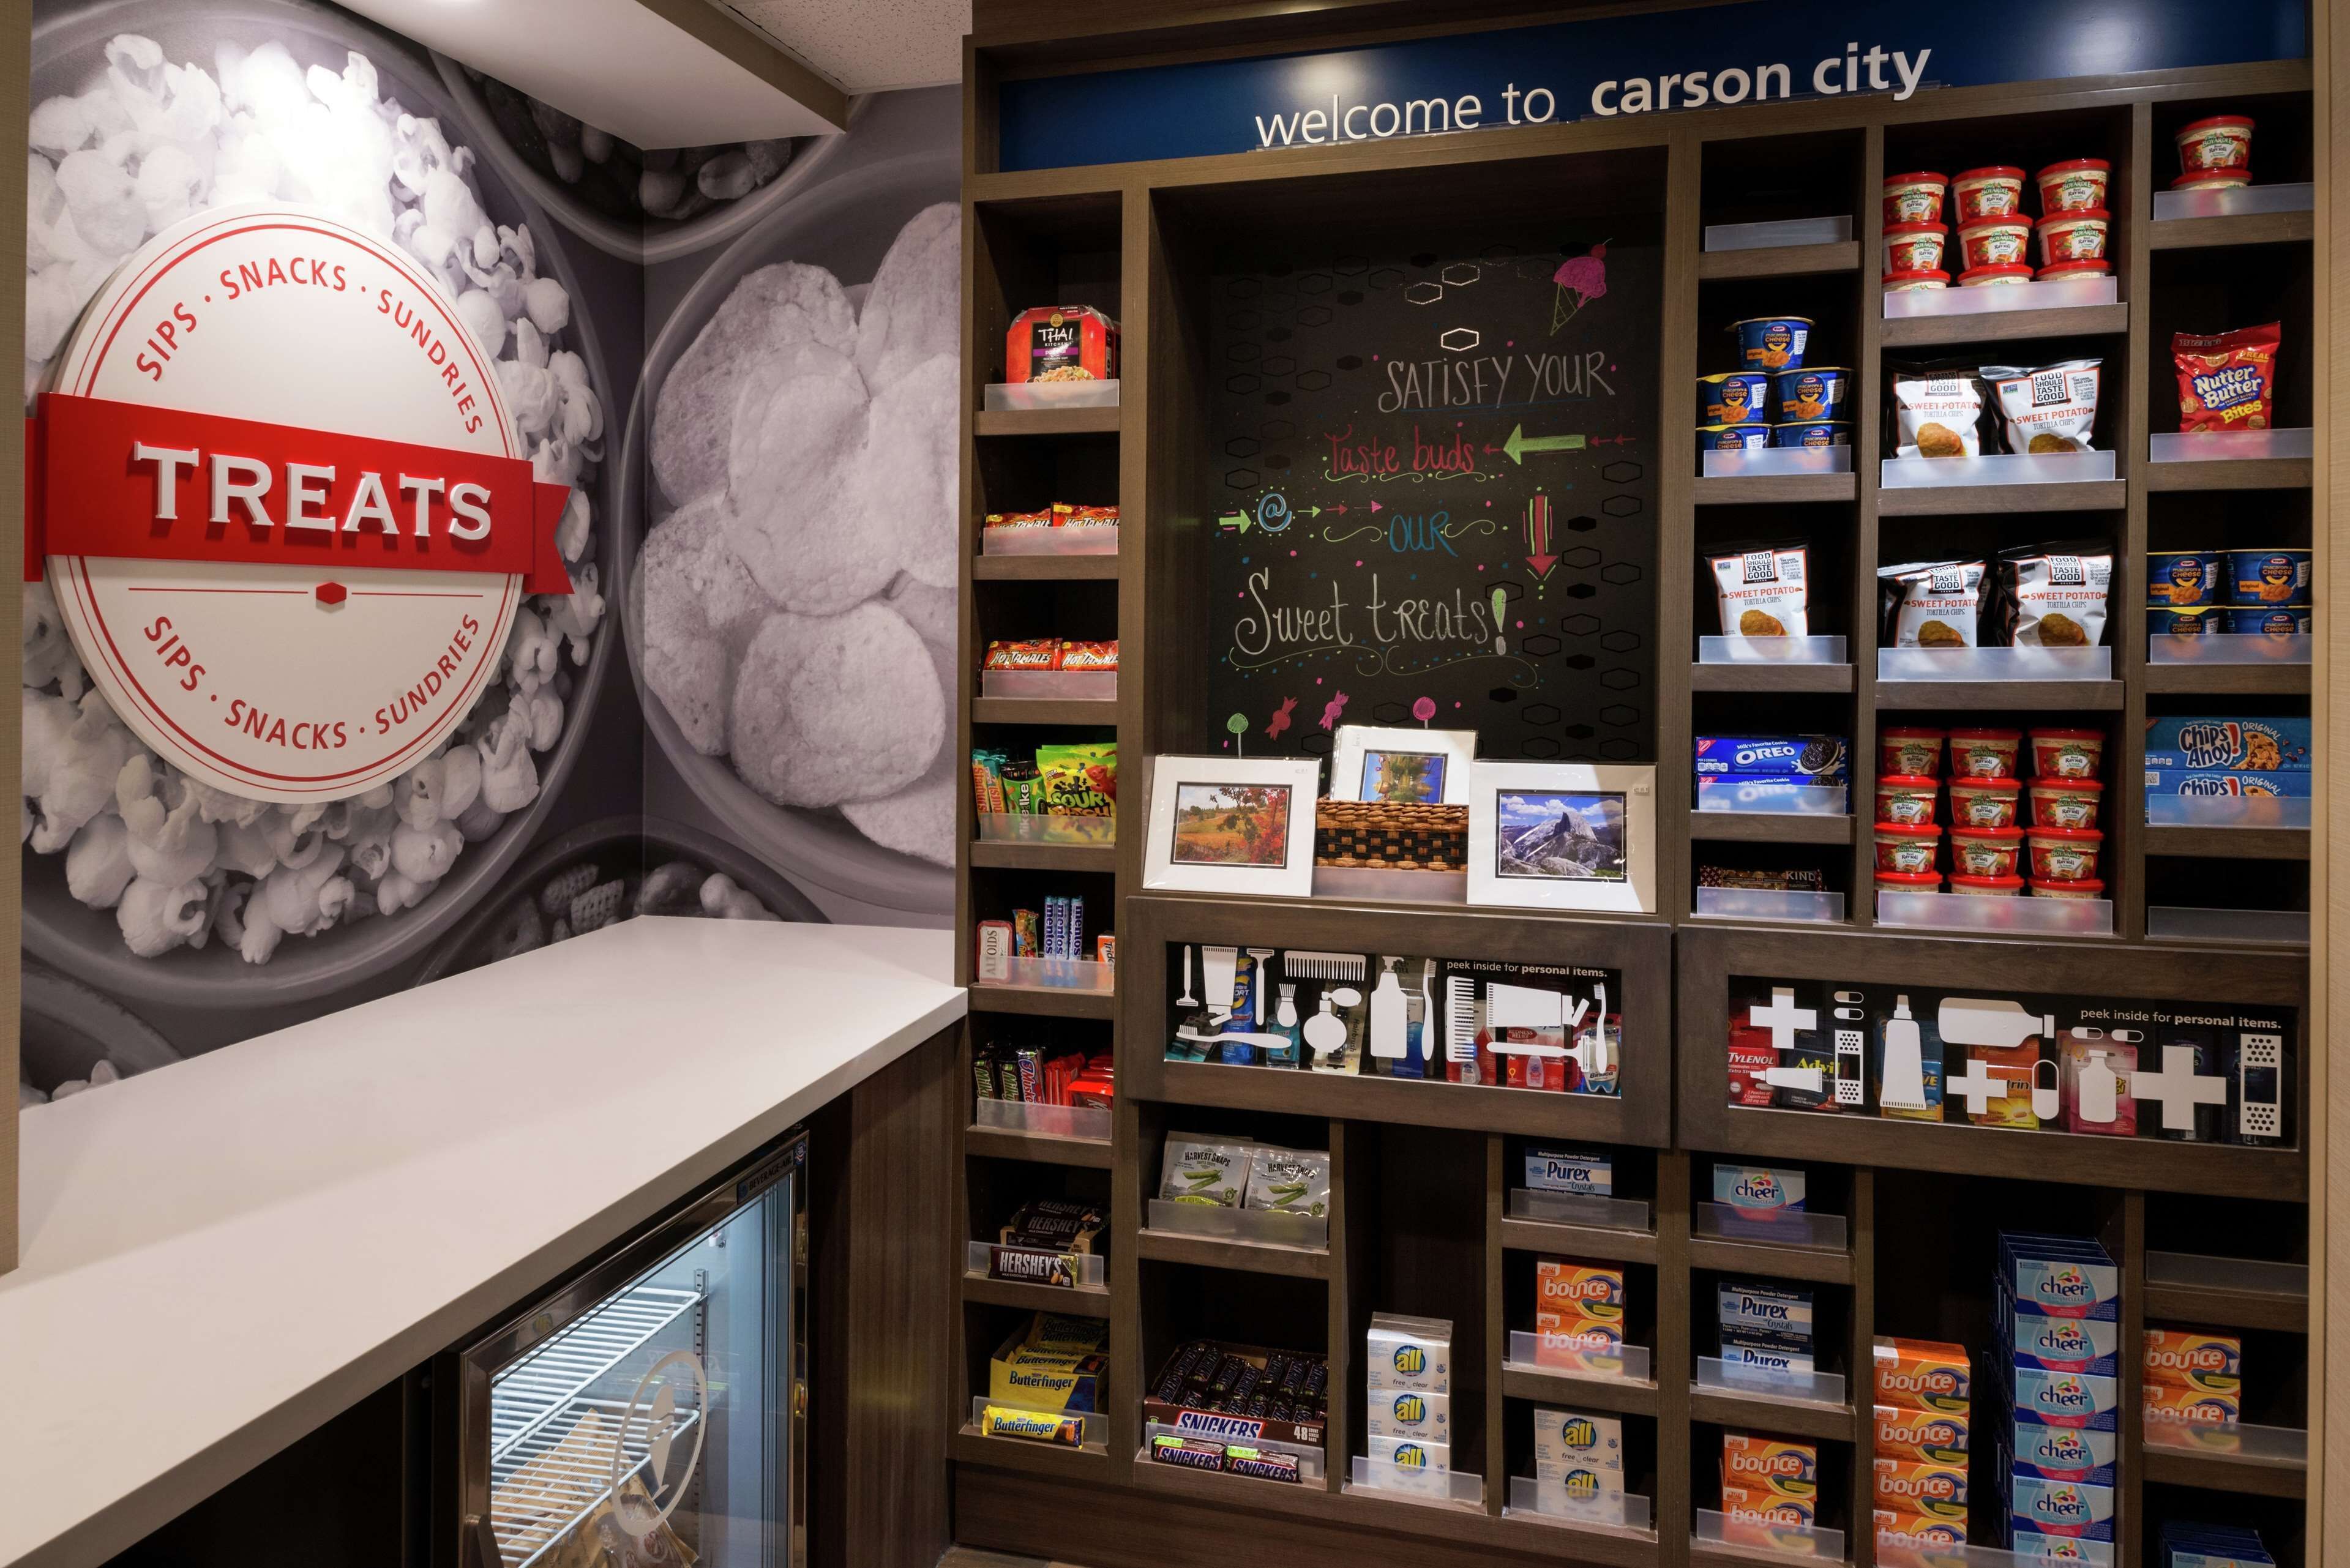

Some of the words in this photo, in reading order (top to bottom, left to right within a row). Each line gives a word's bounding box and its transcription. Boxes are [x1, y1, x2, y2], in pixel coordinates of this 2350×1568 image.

[1254, 94, 1481, 147] welcome
[1501, 82, 1555, 124] to
[1592, 62, 1789, 116] carson
[1813, 42, 1931, 101] city
[1038, 327, 1072, 343] THAI
[135, 302, 198, 381] SIPS
[220, 257, 346, 301] SNACKS
[377, 289, 482, 435] SUNDRIES
[1525, 351, 1615, 403] YOUR
[2034, 371, 2062, 382] FOOD
[2194, 367, 2254, 395] Nutter
[2036, 385, 2063, 394] TASTE
[2037, 392, 2064, 401] GOOD
[2203, 377, 2262, 409] Butter
[2016, 414, 2049, 424] SWEET
[2051, 406, 2088, 418] POTATO
[2220, 400, 2262, 424] Bites
[2033, 420, 2058, 430] TORTILLA
[2059, 418, 2075, 427] CHIPS
[1324, 424, 1399, 475] Taste
[1413, 425, 1475, 473] buds
[134, 441, 492, 541] TREATS
[1390, 511, 1458, 557] OUR
[1748, 570, 1773, 579] GOOD
[1729, 589, 1759, 599] SWEET
[1760, 586, 1794, 596] POTATO
[2030, 592, 2064, 600] SWEET
[2065, 591, 2101, 600] POTATO
[1235, 567, 1353, 654] Sweet
[1011, 651, 1052, 664] TAMALES
[144, 616, 206, 692] SIPS
[225, 698, 346, 750] SNACKS
[375, 614, 479, 734] SUNDRIES
[2180, 725, 2229, 753] Chips
[2242, 721, 2282, 741] ORIGINAL
[1734, 747, 1796, 765] OREO
[2242, 775, 2281, 795] ORIGINAL
[1050, 791, 1105, 808] SOUR
[1786, 871, 1816, 882] KIND
[1056, 905, 1065, 955] mentos
[1073, 905, 1083, 957] mentos
[1447, 961, 1470, 970] peek
[1473, 961, 1502, 972] inside
[1504, 963, 1519, 972] for
[1522, 965, 1570, 976] personal
[1573, 968, 1608, 977] items.
[2081, 1009, 2110, 1020] peek
[2114, 1010, 2149, 1022] inside
[2152, 1011, 2172, 1023] for
[2174, 1014, 2234, 1028] personal
[2238, 1017, 2282, 1029] items.
[1349, 1018, 1360, 1053] Hairbrush
[1728, 1052, 1775, 1065] TYLENOL
[1184, 1151, 1211, 1161] HARVEST
[1211, 1152, 1231, 1167] SNAPS
[1538, 1151, 1564, 1159] Multipurpose
[1268, 1162, 1295, 1173] HARVEST
[1547, 1160, 1591, 1182] Purex
[1571, 1181, 1596, 1192] Crystals
[1735, 1179, 1779, 1200] cheer
[1000, 1252, 1062, 1277] HERSHEY'S
[1544, 1277, 1608, 1299] bounce
[1732, 1286, 1760, 1295] Multipurpose
[1776, 1291, 1799, 1300] Detergent
[2041, 1275, 2089, 1297] cheer
[1741, 1296, 1789, 1320] Purex
[1767, 1319, 1793, 1331] Crystals
[2039, 1330, 2088, 1351] cheer
[1016, 1355, 1079, 1366] Butterfinger
[1396, 1348, 1423, 1372] all
[2146, 1345, 2222, 1368] bounce
[1009, 1370, 1074, 1391] Butterfinger
[1880, 1370, 1953, 1393] bounce
[2040, 1384, 2088, 1406] cheer
[1396, 1397, 1423, 1421] all
[994, 1417, 1056, 1436] Butterfinger
[1294, 1425, 1308, 1440] 48
[1565, 1421, 1593, 1446] all
[1880, 1423, 1952, 1444] bounce
[1160, 1447, 1221, 1469] SNICKERS
[2038, 1439, 2087, 1460] cheer
[1233, 1460, 1297, 1482] SNICKERS
[1732, 1451, 1800, 1475] bounce
[1879, 1474, 1951, 1496] bounce
[2037, 1494, 2084, 1515] cheer
